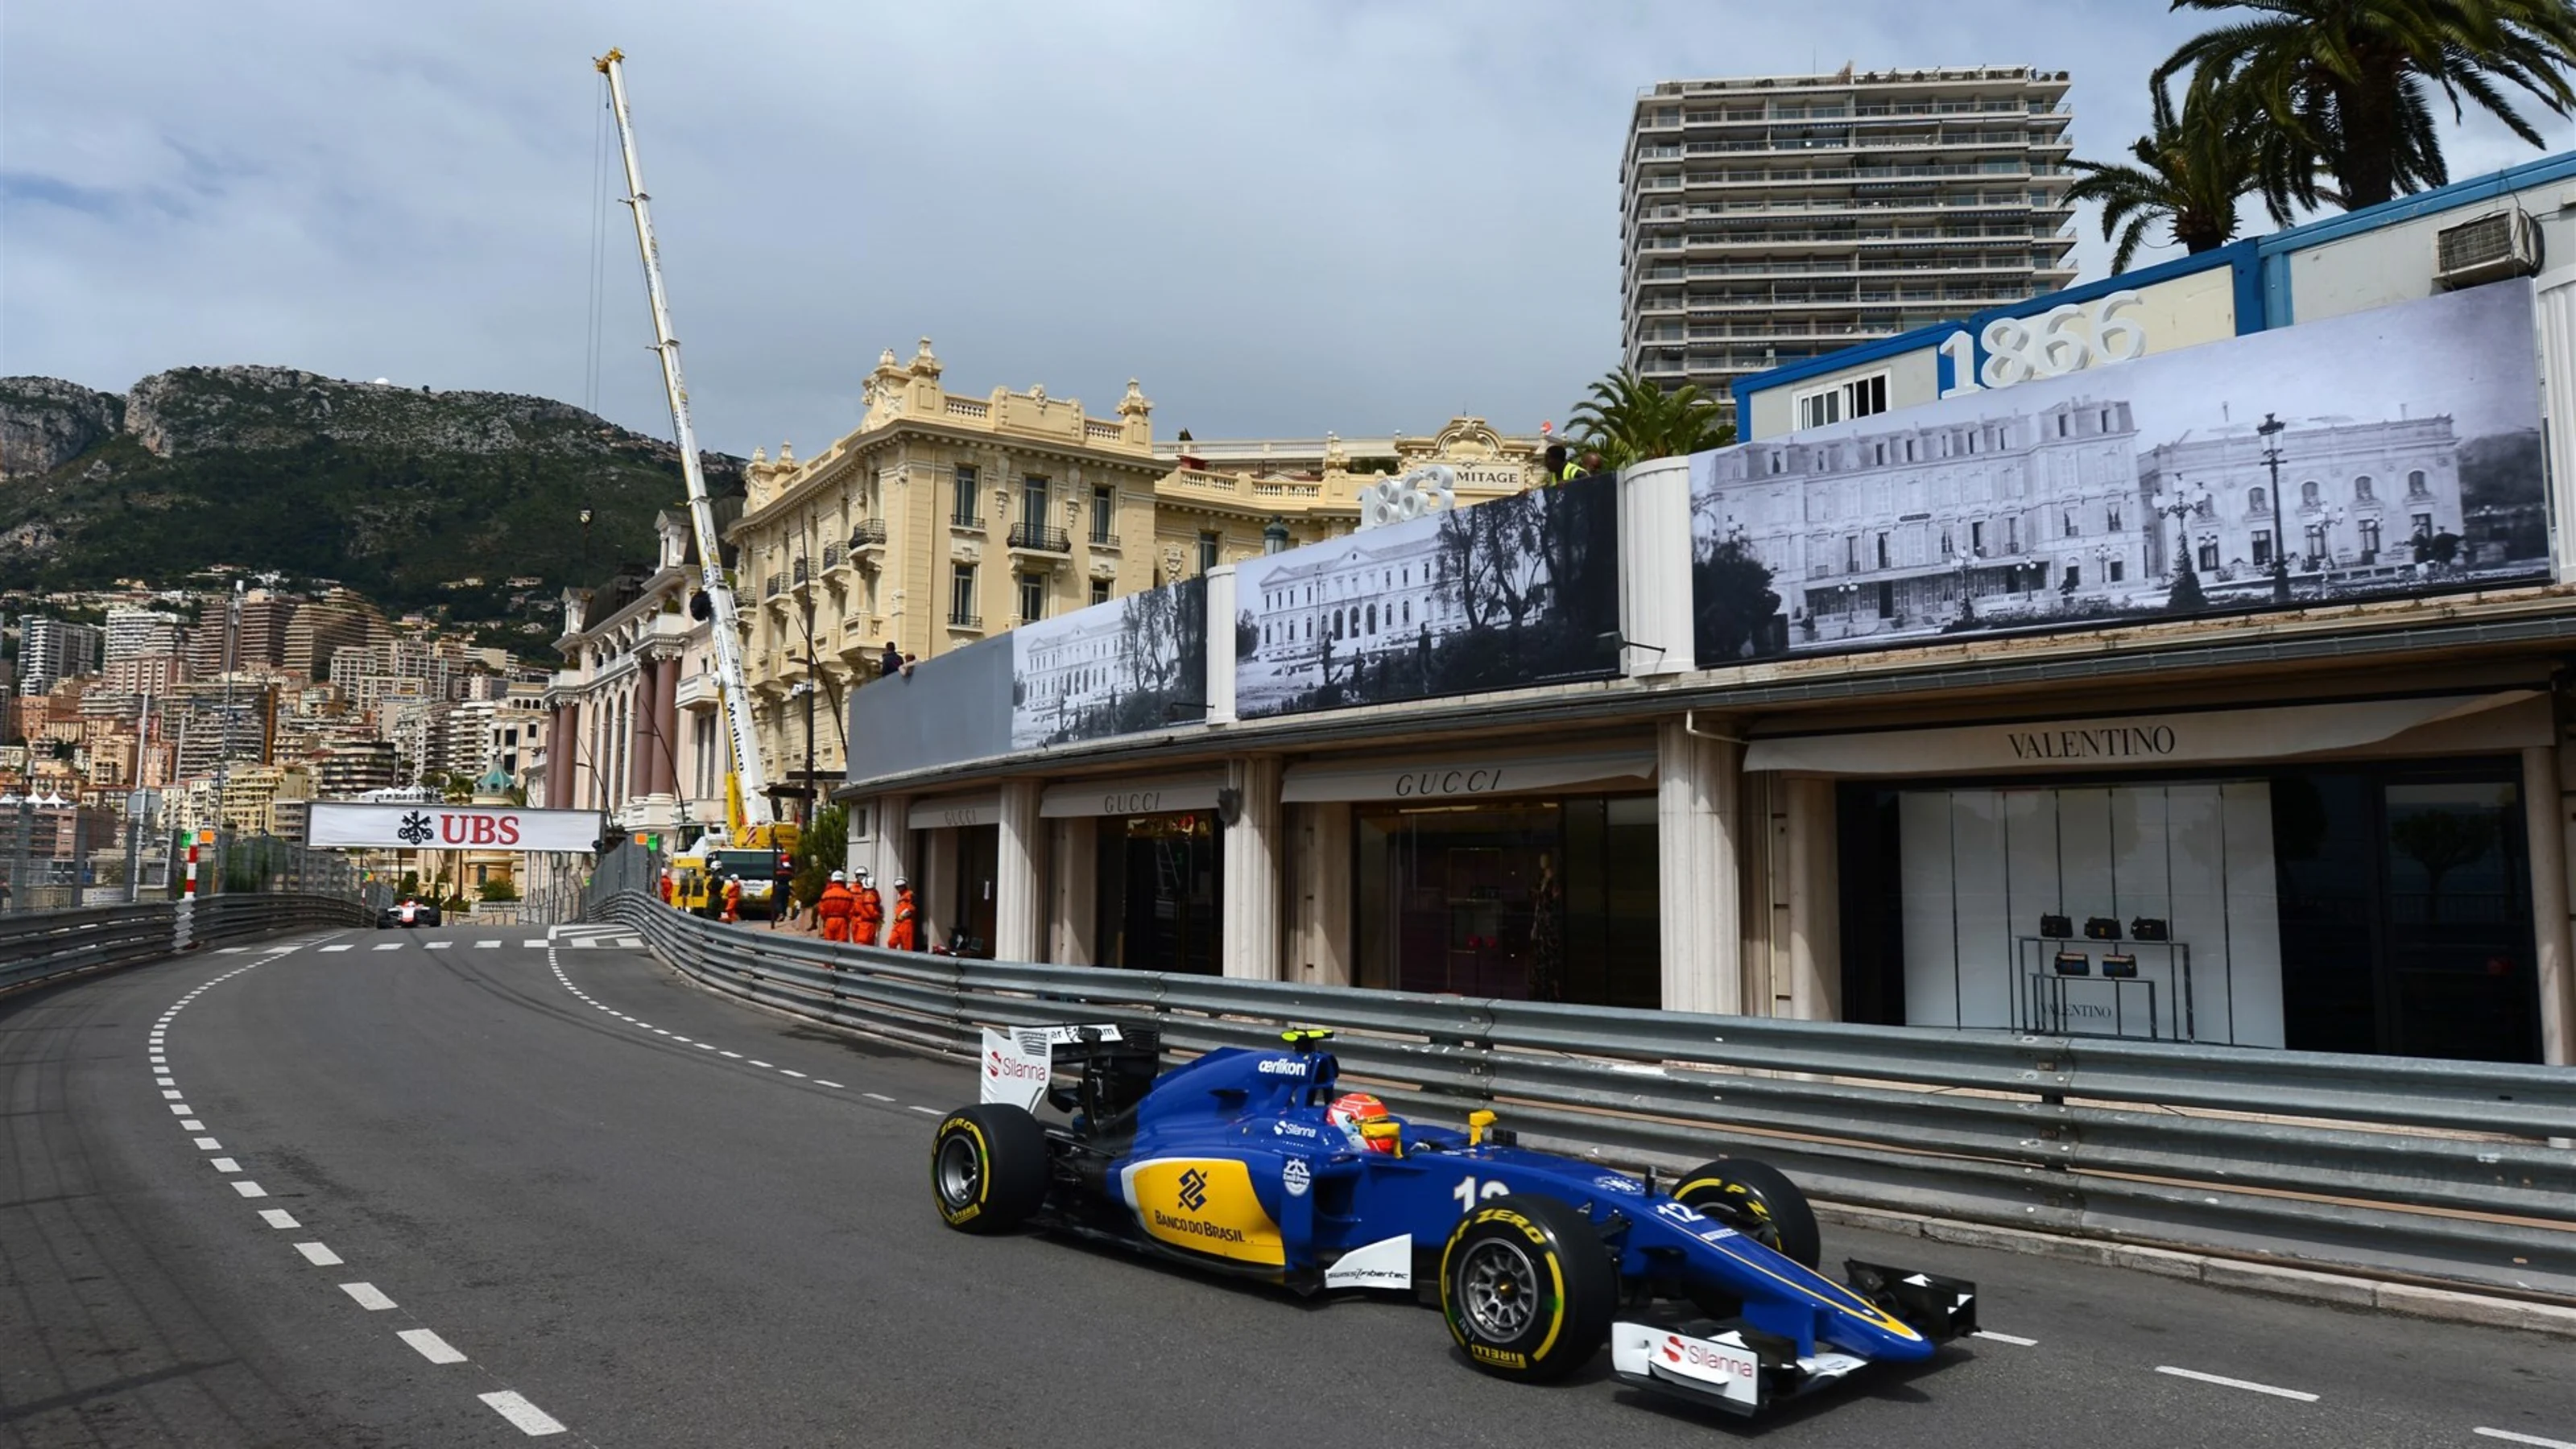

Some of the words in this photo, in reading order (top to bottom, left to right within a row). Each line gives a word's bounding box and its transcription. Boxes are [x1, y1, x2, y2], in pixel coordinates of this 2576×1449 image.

[1939, 290, 2147, 399] 1866
[1456, 471, 1519, 484] MITAGE
[1354, 465, 1455, 533] 1863
[727, 702, 745, 772] Mediaco
[2007, 724, 2176, 759] VALENTINO
[1396, 769, 1502, 796] GUCCI
[944, 808, 977, 826] GUCCI
[1104, 791, 1160, 815] GUCCI
[440, 814, 520, 844] UBS
[1003, 1057, 1046, 1082] Silanna
[1285, 1123, 1317, 1138] Silanna
[1155, 1209, 1188, 1232] BANCO
[1189, 1220, 1203, 1236] DO
[1203, 1220, 1247, 1243] BRASIL
[1475, 1208, 1547, 1245] ZERO
[1656, 1203, 1706, 1223] 12
[1688, 1345, 1754, 1378] Silanna
